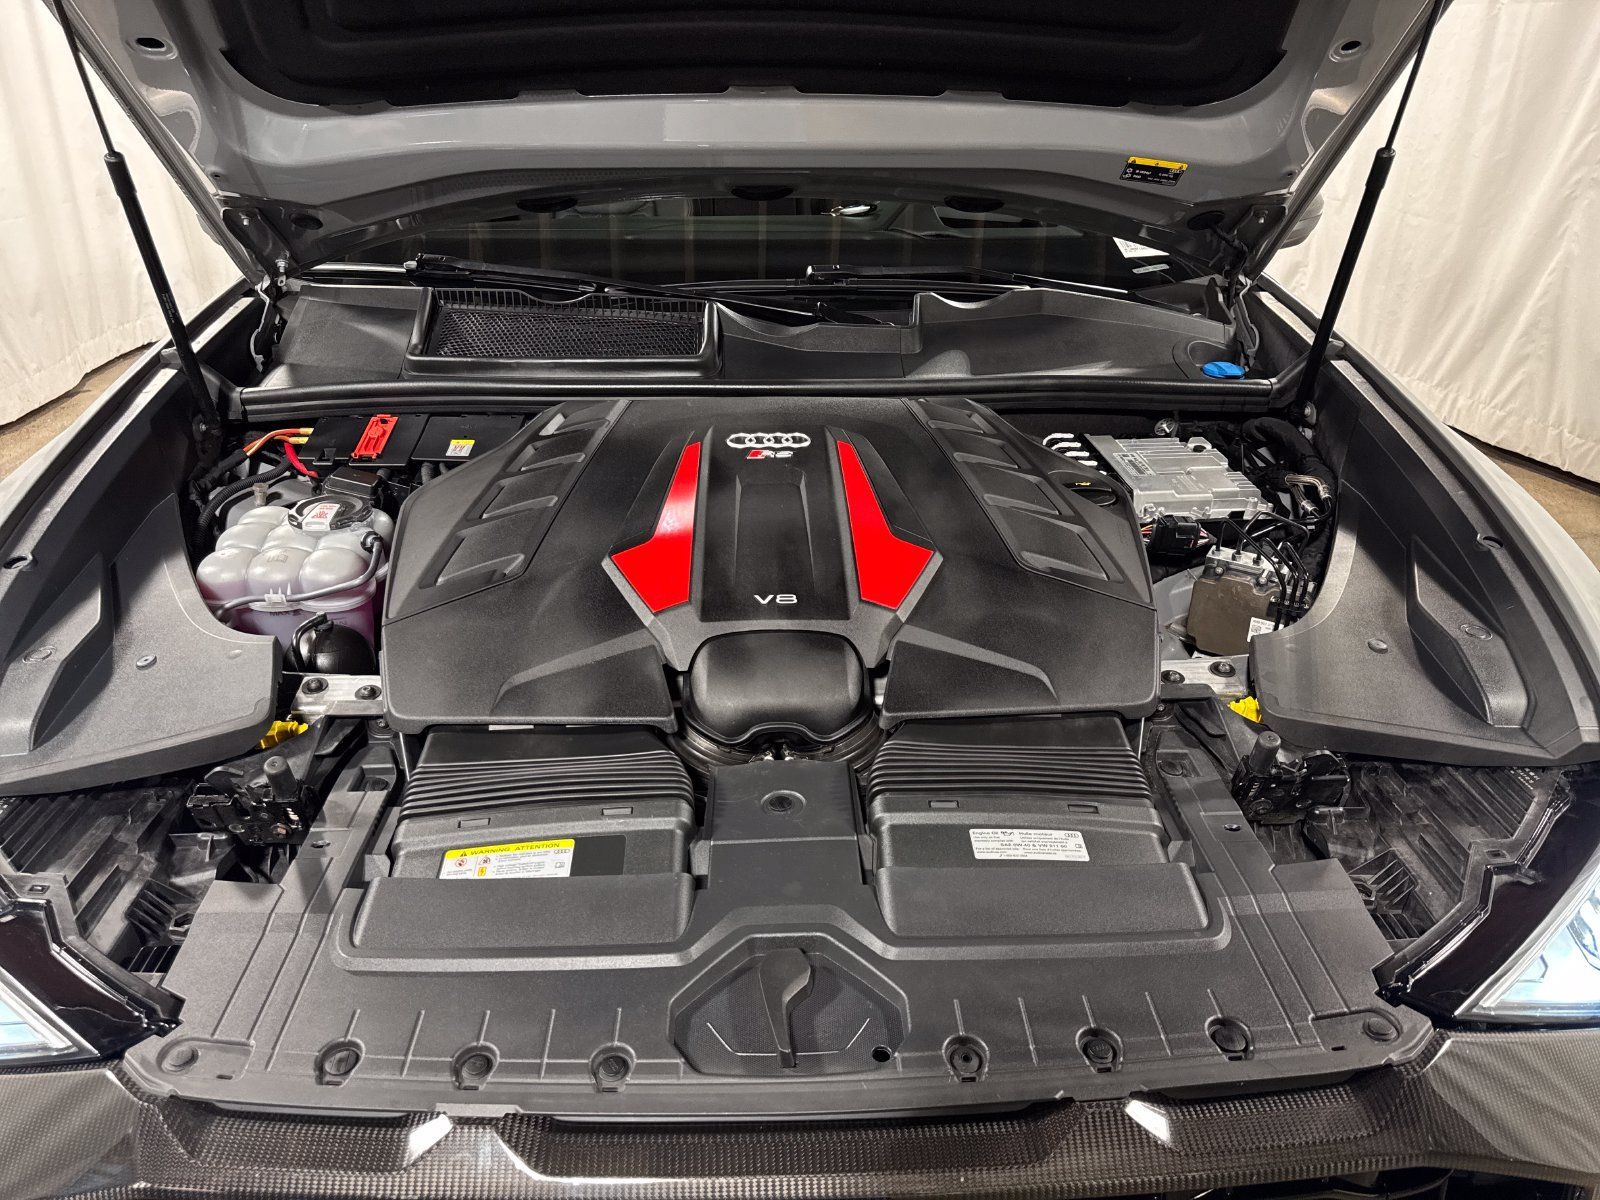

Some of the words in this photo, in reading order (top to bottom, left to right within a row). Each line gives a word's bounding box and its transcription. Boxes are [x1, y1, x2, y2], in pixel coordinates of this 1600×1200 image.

[753, 594, 798, 605] V8
[470, 847, 510, 856] WARNING
[514, 843, 560, 851] ATTENTION
